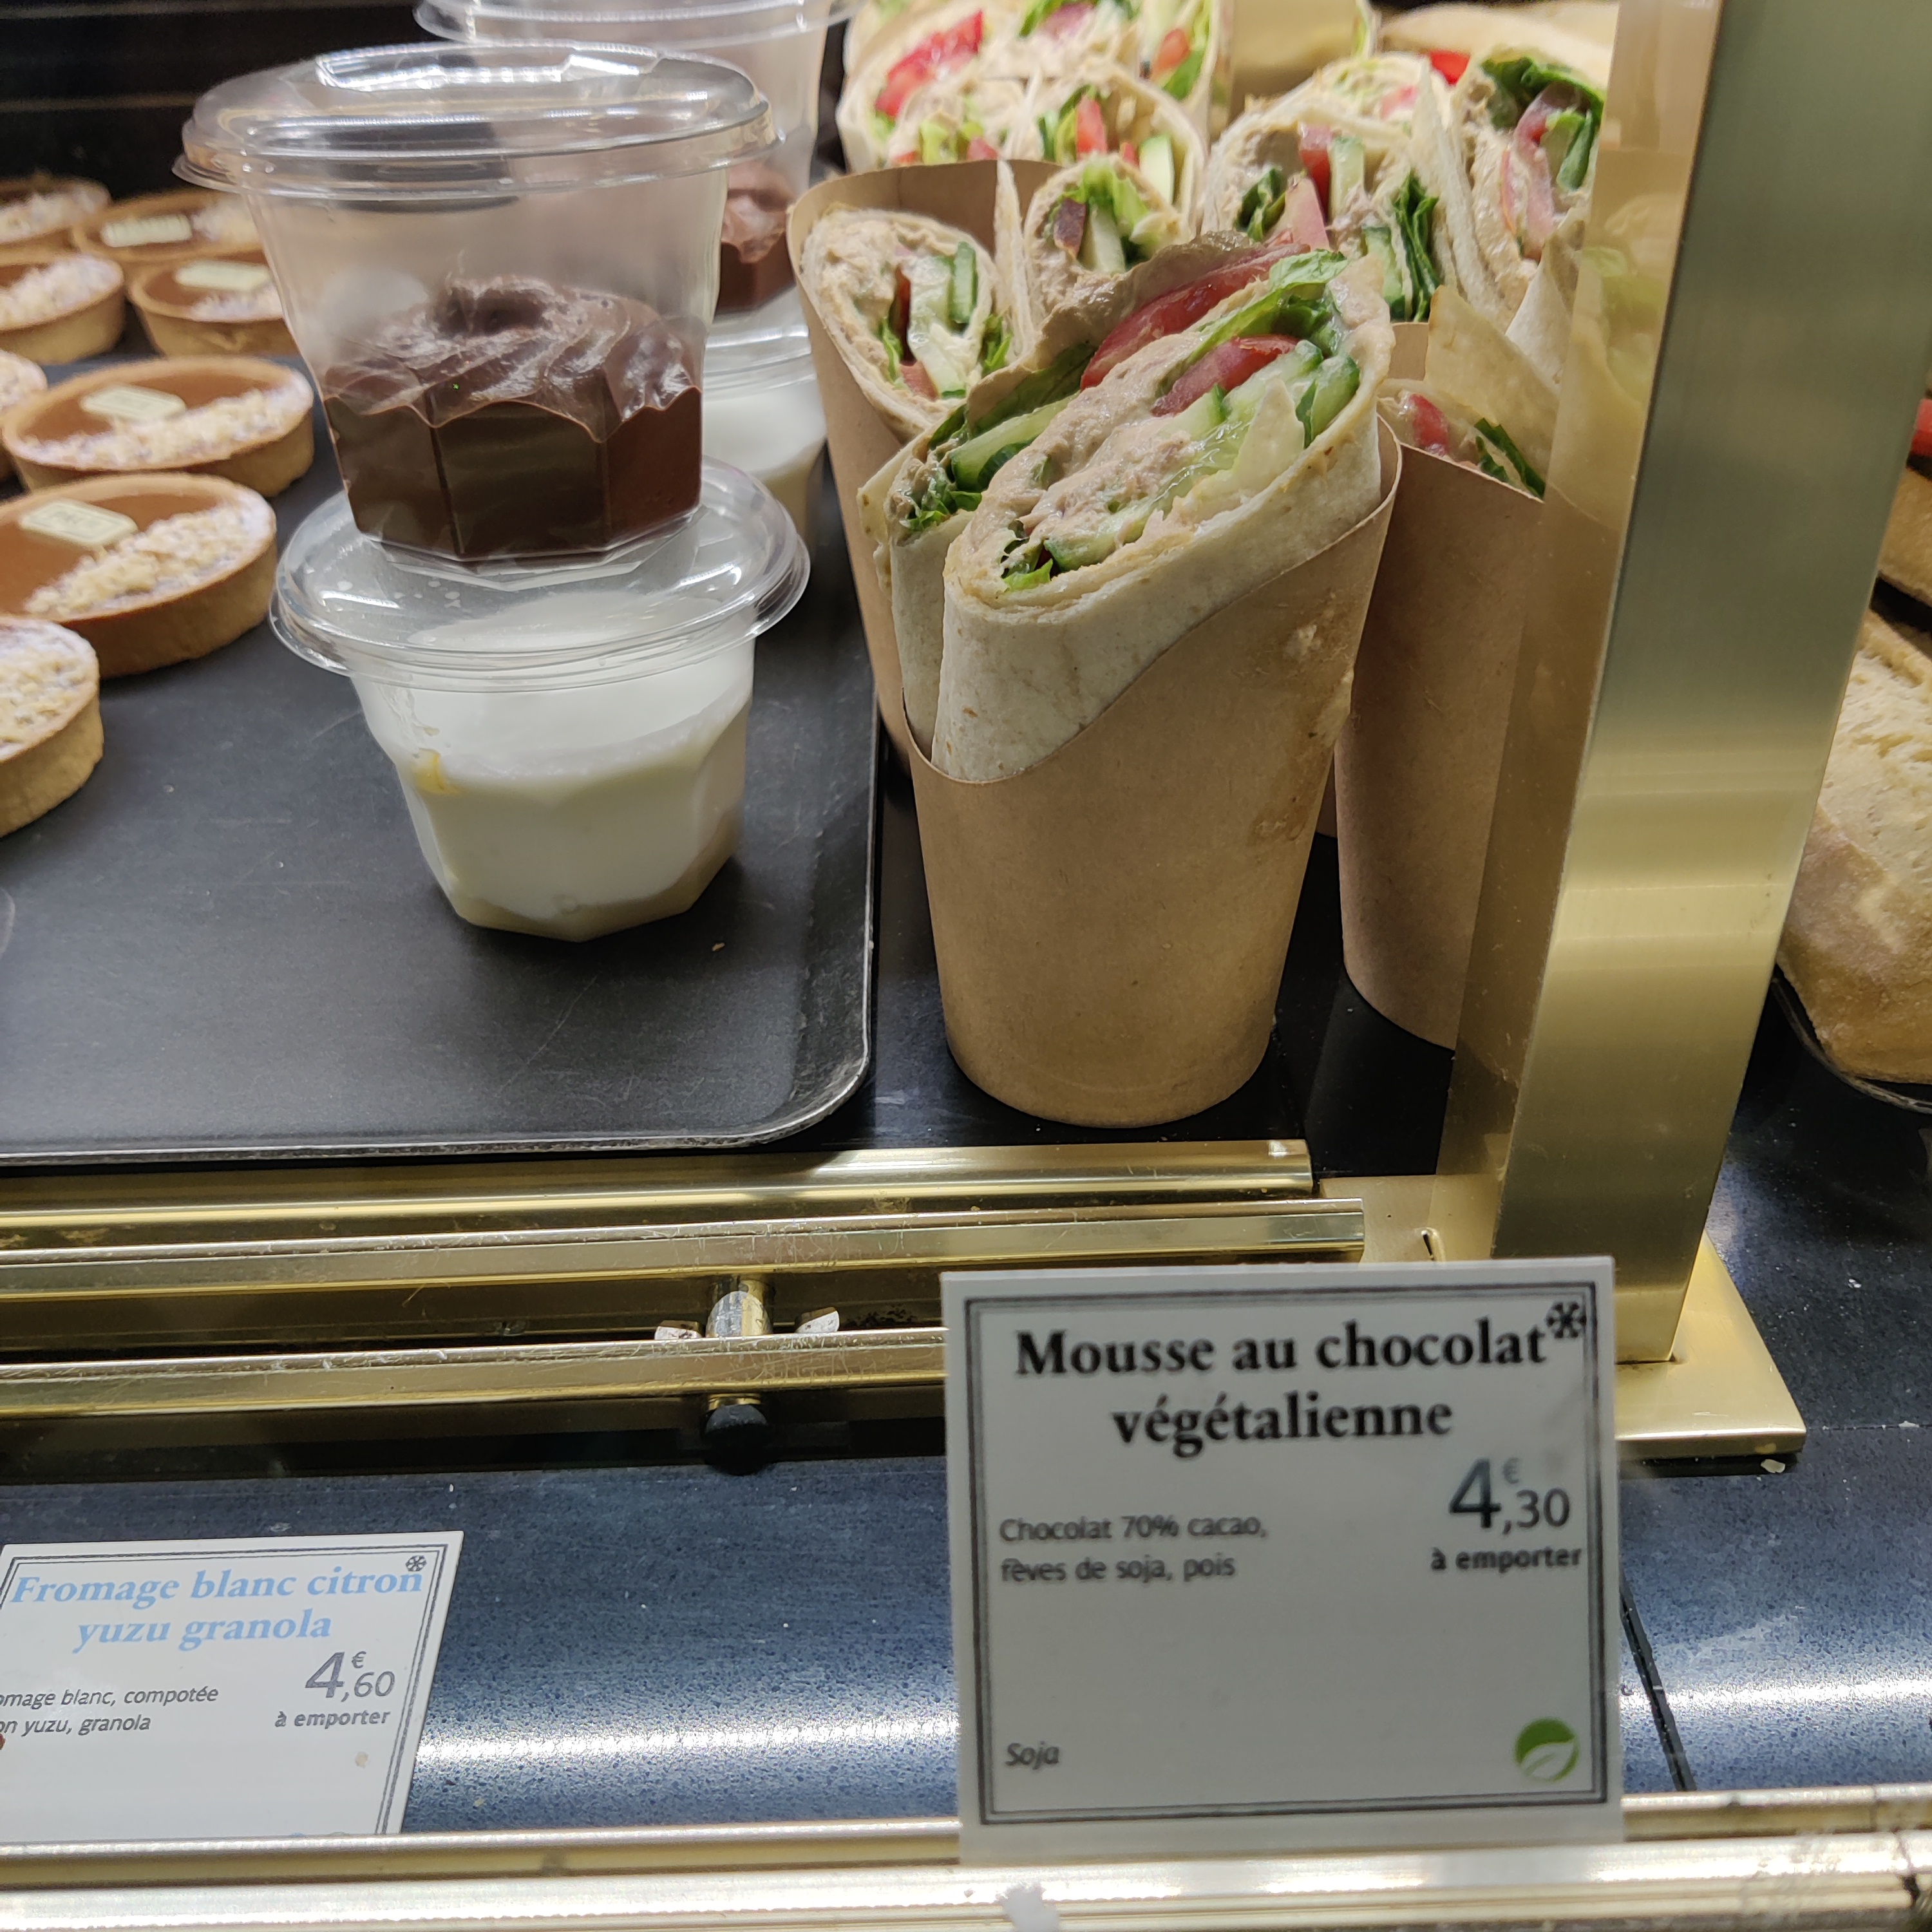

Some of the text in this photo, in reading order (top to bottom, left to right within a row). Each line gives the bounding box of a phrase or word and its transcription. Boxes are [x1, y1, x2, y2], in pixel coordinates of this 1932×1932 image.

[1016, 1315, 1546, 1375] Mousse au chocolat
[1110, 1390, 1453, 1459] végétalienne
[999, 1514, 1267, 1542] Chocolat 70% cacao,
[1075, 1556, 1107, 1580] de
[1115, 1554, 1173, 1584] soja,
[1182, 1551, 1236, 1582] pois
[1430, 1547, 1581, 1573] à emporter
[9, 1566, 422, 1610] Fromage blanc citron
[71, 1607, 331, 1654] yuzu granola
[61, 1689, 117, 1707] blanc,
[124, 1686, 219, 1707] compotée
[21, 1719, 72, 1738] yuzu,
[77, 1714, 151, 1736] granola
[274, 1710, 391, 1730] à emporter
[1005, 1740, 1059, 1770] Soja
